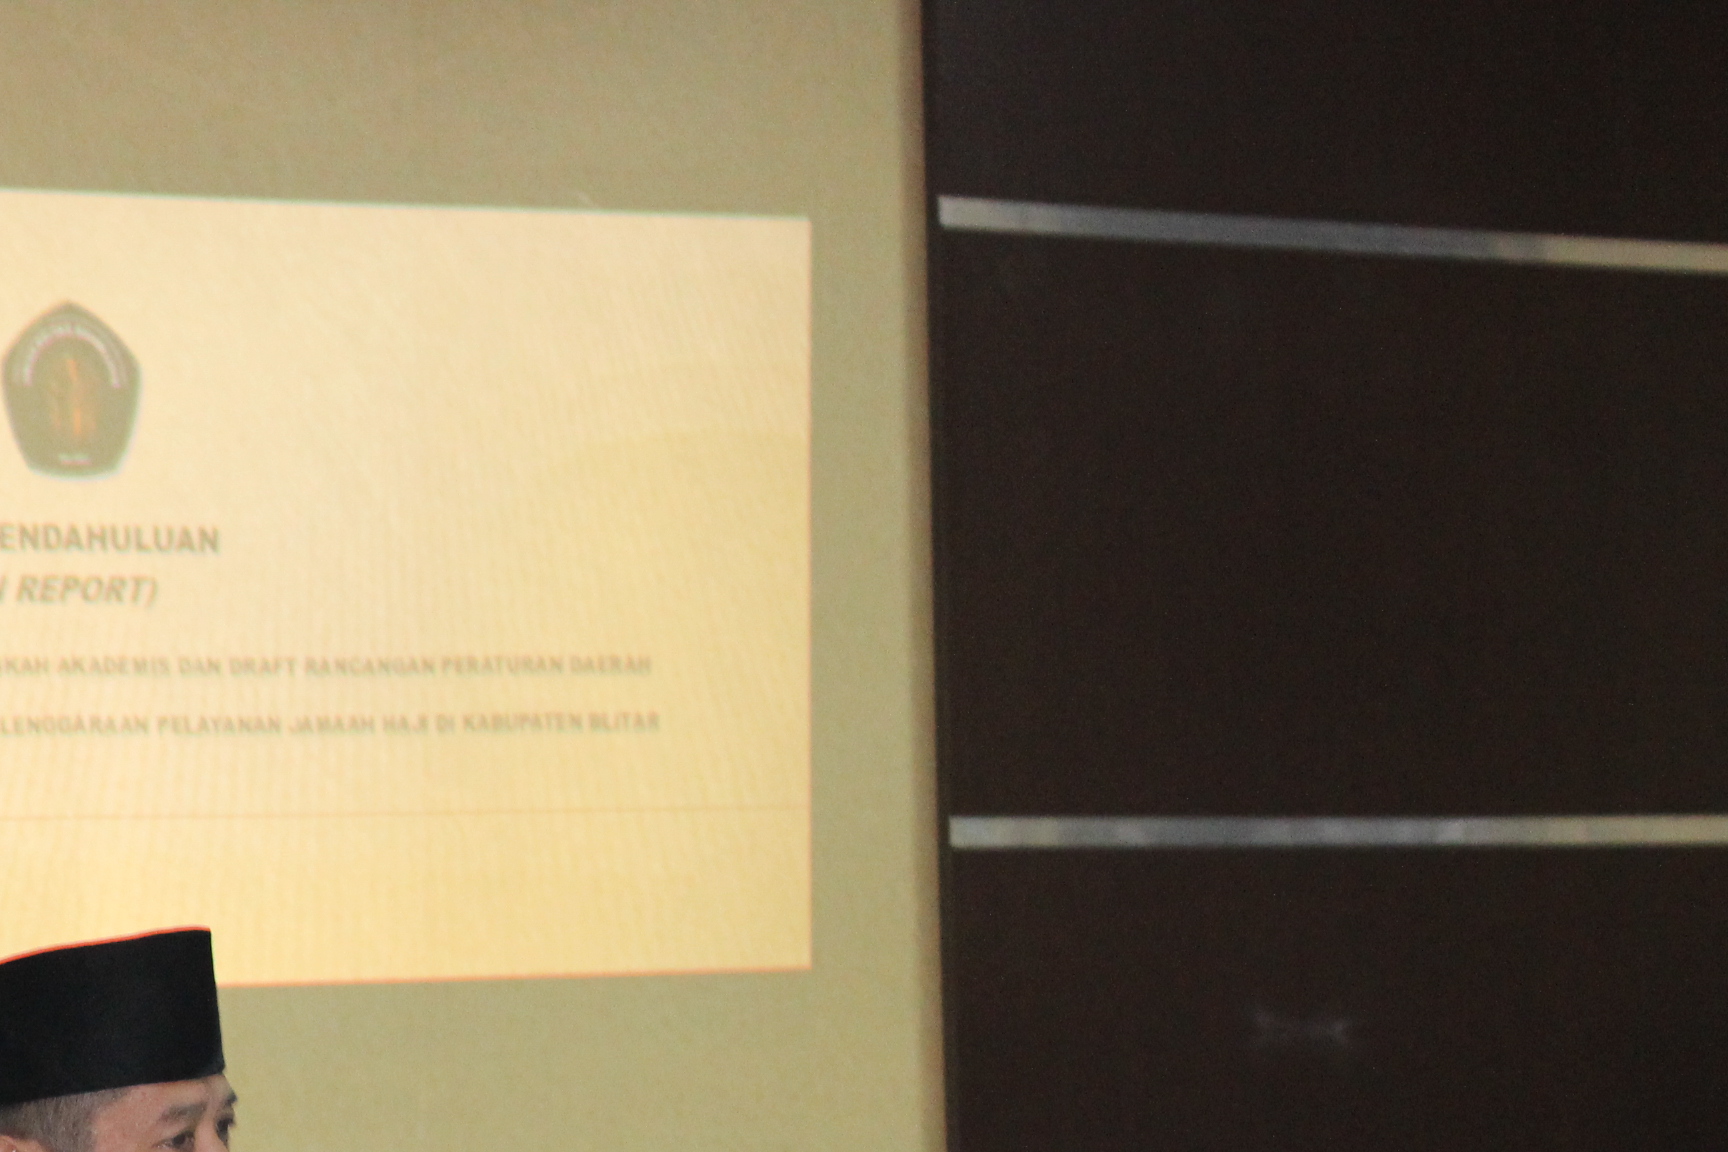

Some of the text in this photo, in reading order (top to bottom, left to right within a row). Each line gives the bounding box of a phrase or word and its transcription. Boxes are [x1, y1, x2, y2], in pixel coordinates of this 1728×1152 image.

[17, 576, 159, 608] REPORT)
[56, 655, 171, 676] AKADEMIS
[177, 655, 223, 676] DAN
[228, 655, 298, 676] DRAFT
[304, 655, 436, 676] RANCANGAN
[441, 655, 564, 676] PERATURAN
[570, 655, 652, 676] DAERAH
[157, 715, 282, 738] PELAYANAN
[462, 712, 583, 734] KABUPATEN
[589, 711, 660, 733] BLITAR
